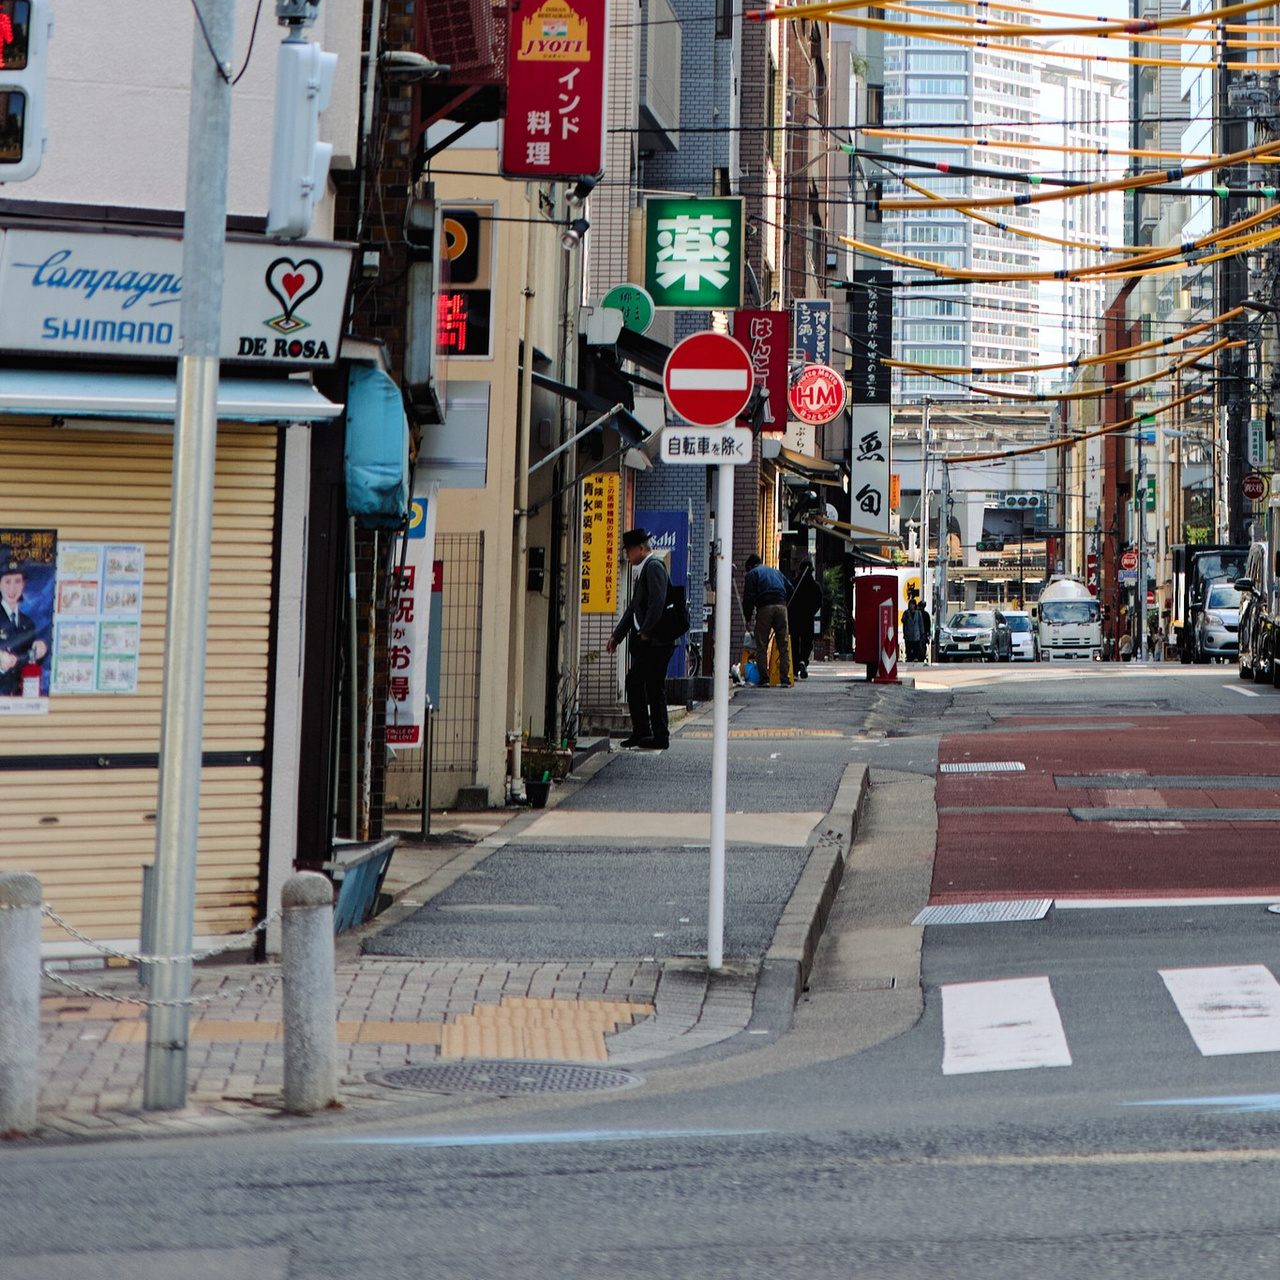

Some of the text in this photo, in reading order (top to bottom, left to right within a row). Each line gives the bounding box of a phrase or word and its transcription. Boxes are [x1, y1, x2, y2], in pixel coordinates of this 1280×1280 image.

[522, 40, 584, 56] JYOTI
[558, 67, 581, 140] インド
[526, 110, 552, 166] 料理
[656, 214, 732, 291] 薬
[42, 317, 173, 345] SHIMANO
[238, 337, 330, 359] DE ROSA
[796, 384, 837, 407] HM
[668, 436, 744, 456] 自転車を除く
